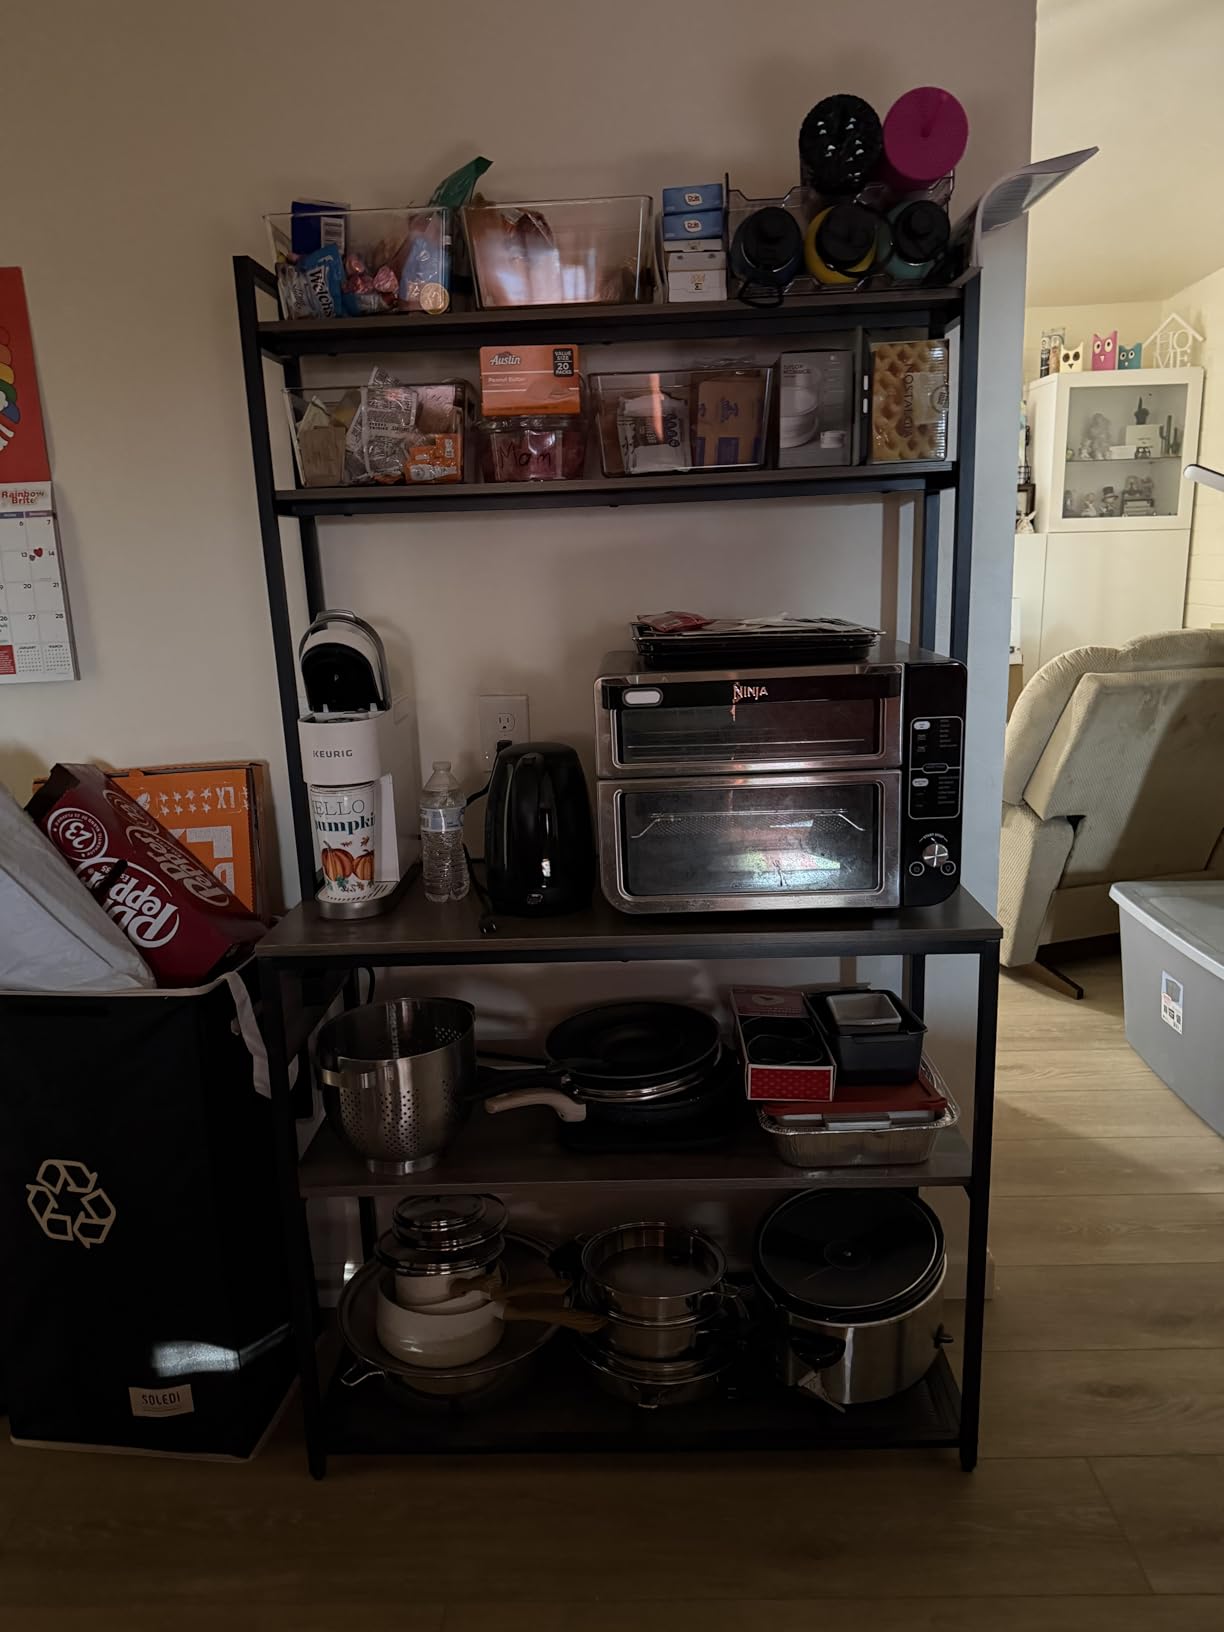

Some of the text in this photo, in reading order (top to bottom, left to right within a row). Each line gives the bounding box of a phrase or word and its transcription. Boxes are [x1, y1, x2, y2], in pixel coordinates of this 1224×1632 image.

[490, 354, 521, 366] Austin
[557, 362, 570, 370] 20
[733, 682, 768, 700] NINJA
[313, 749, 353, 758] KEURIG
[315, 812, 376, 835] umpki
[64, 822, 92, 849] 23
[133, 832, 228, 906] Pepper
[146, 852, 190, 883] Dr
[82, 870, 178, 947] Peppr
[142, 1391, 181, 1406] SOLEDI
